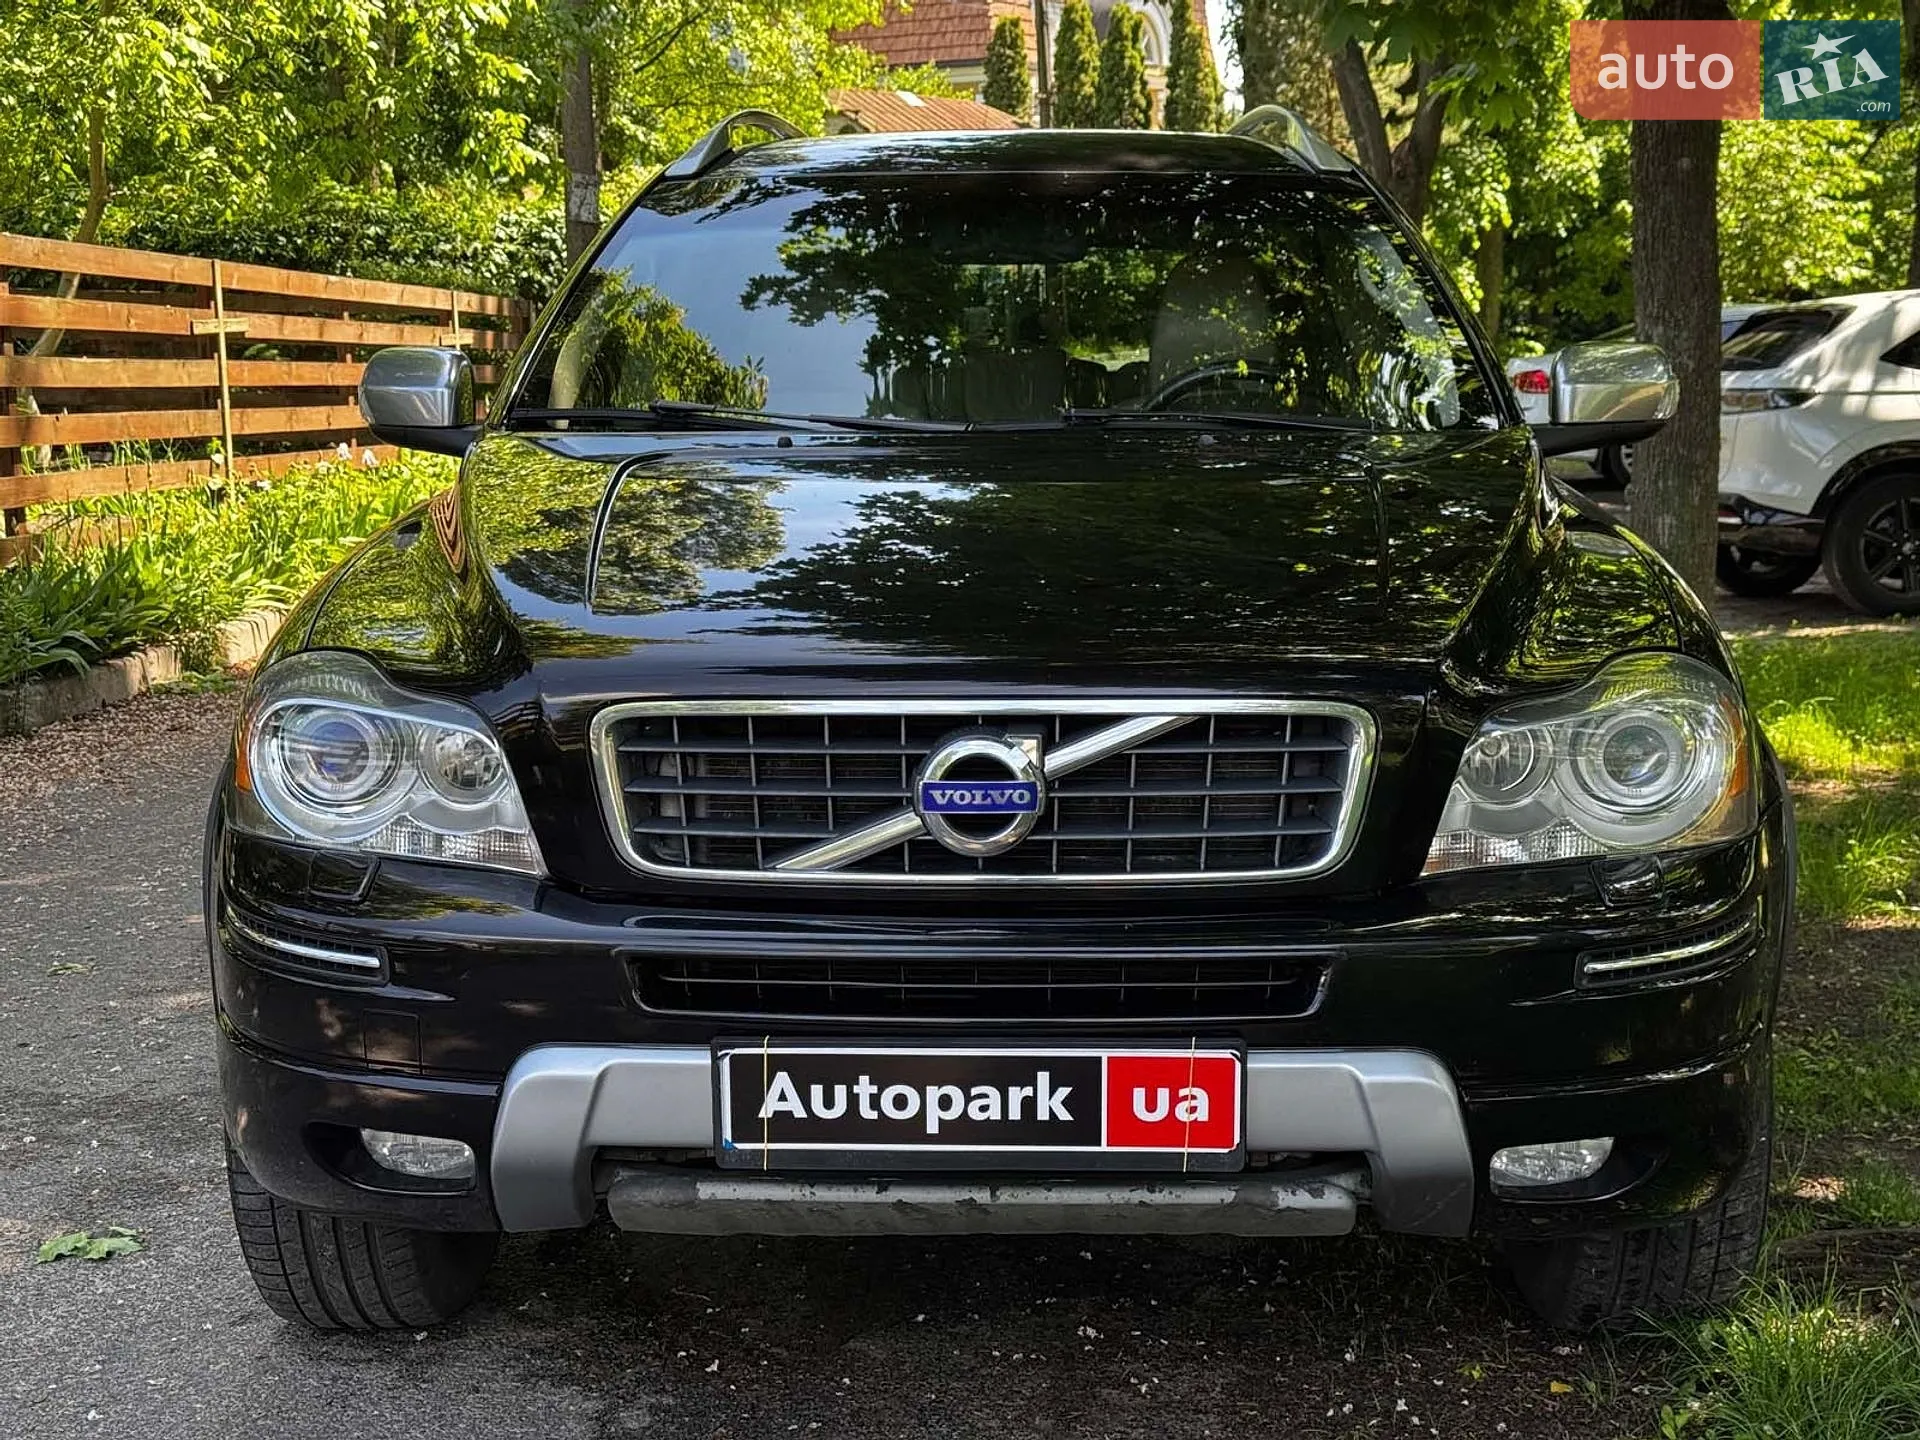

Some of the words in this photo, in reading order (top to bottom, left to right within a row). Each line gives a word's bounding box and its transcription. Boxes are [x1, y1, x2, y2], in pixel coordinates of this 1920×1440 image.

[928, 789, 1032, 805] VOLVO
[758, 1071, 1075, 1134] Autopark
[1132, 1087, 1210, 1122] ua
